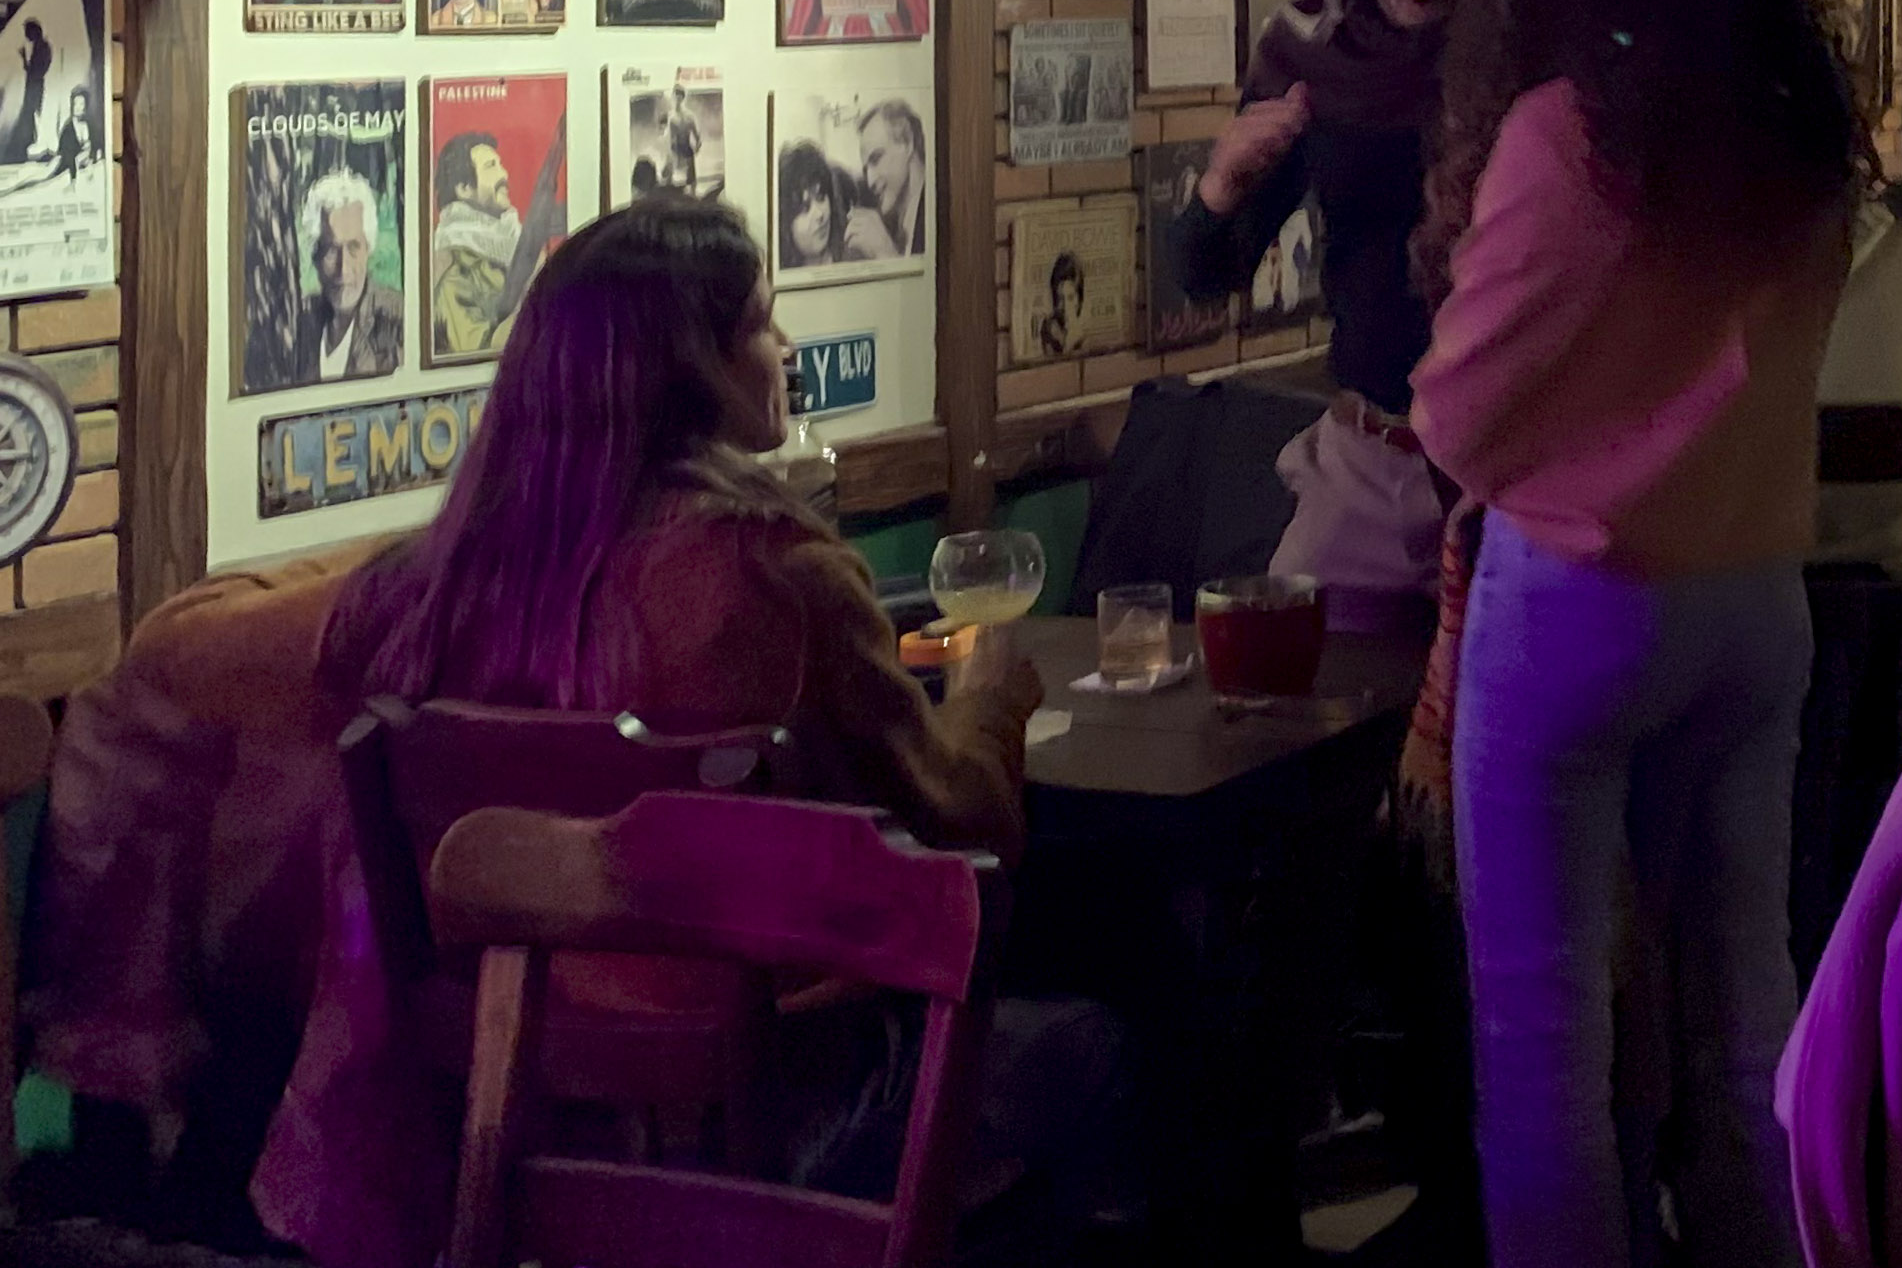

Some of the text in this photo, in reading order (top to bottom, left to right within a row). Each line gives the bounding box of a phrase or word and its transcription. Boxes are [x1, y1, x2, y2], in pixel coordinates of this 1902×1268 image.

[254, 9, 401, 31] STING LIKE A BEE
[438, 83, 508, 102] PALESTINE
[247, 108, 406, 136] CLOUDS OF MAY
[838, 340, 872, 382] BLVD
